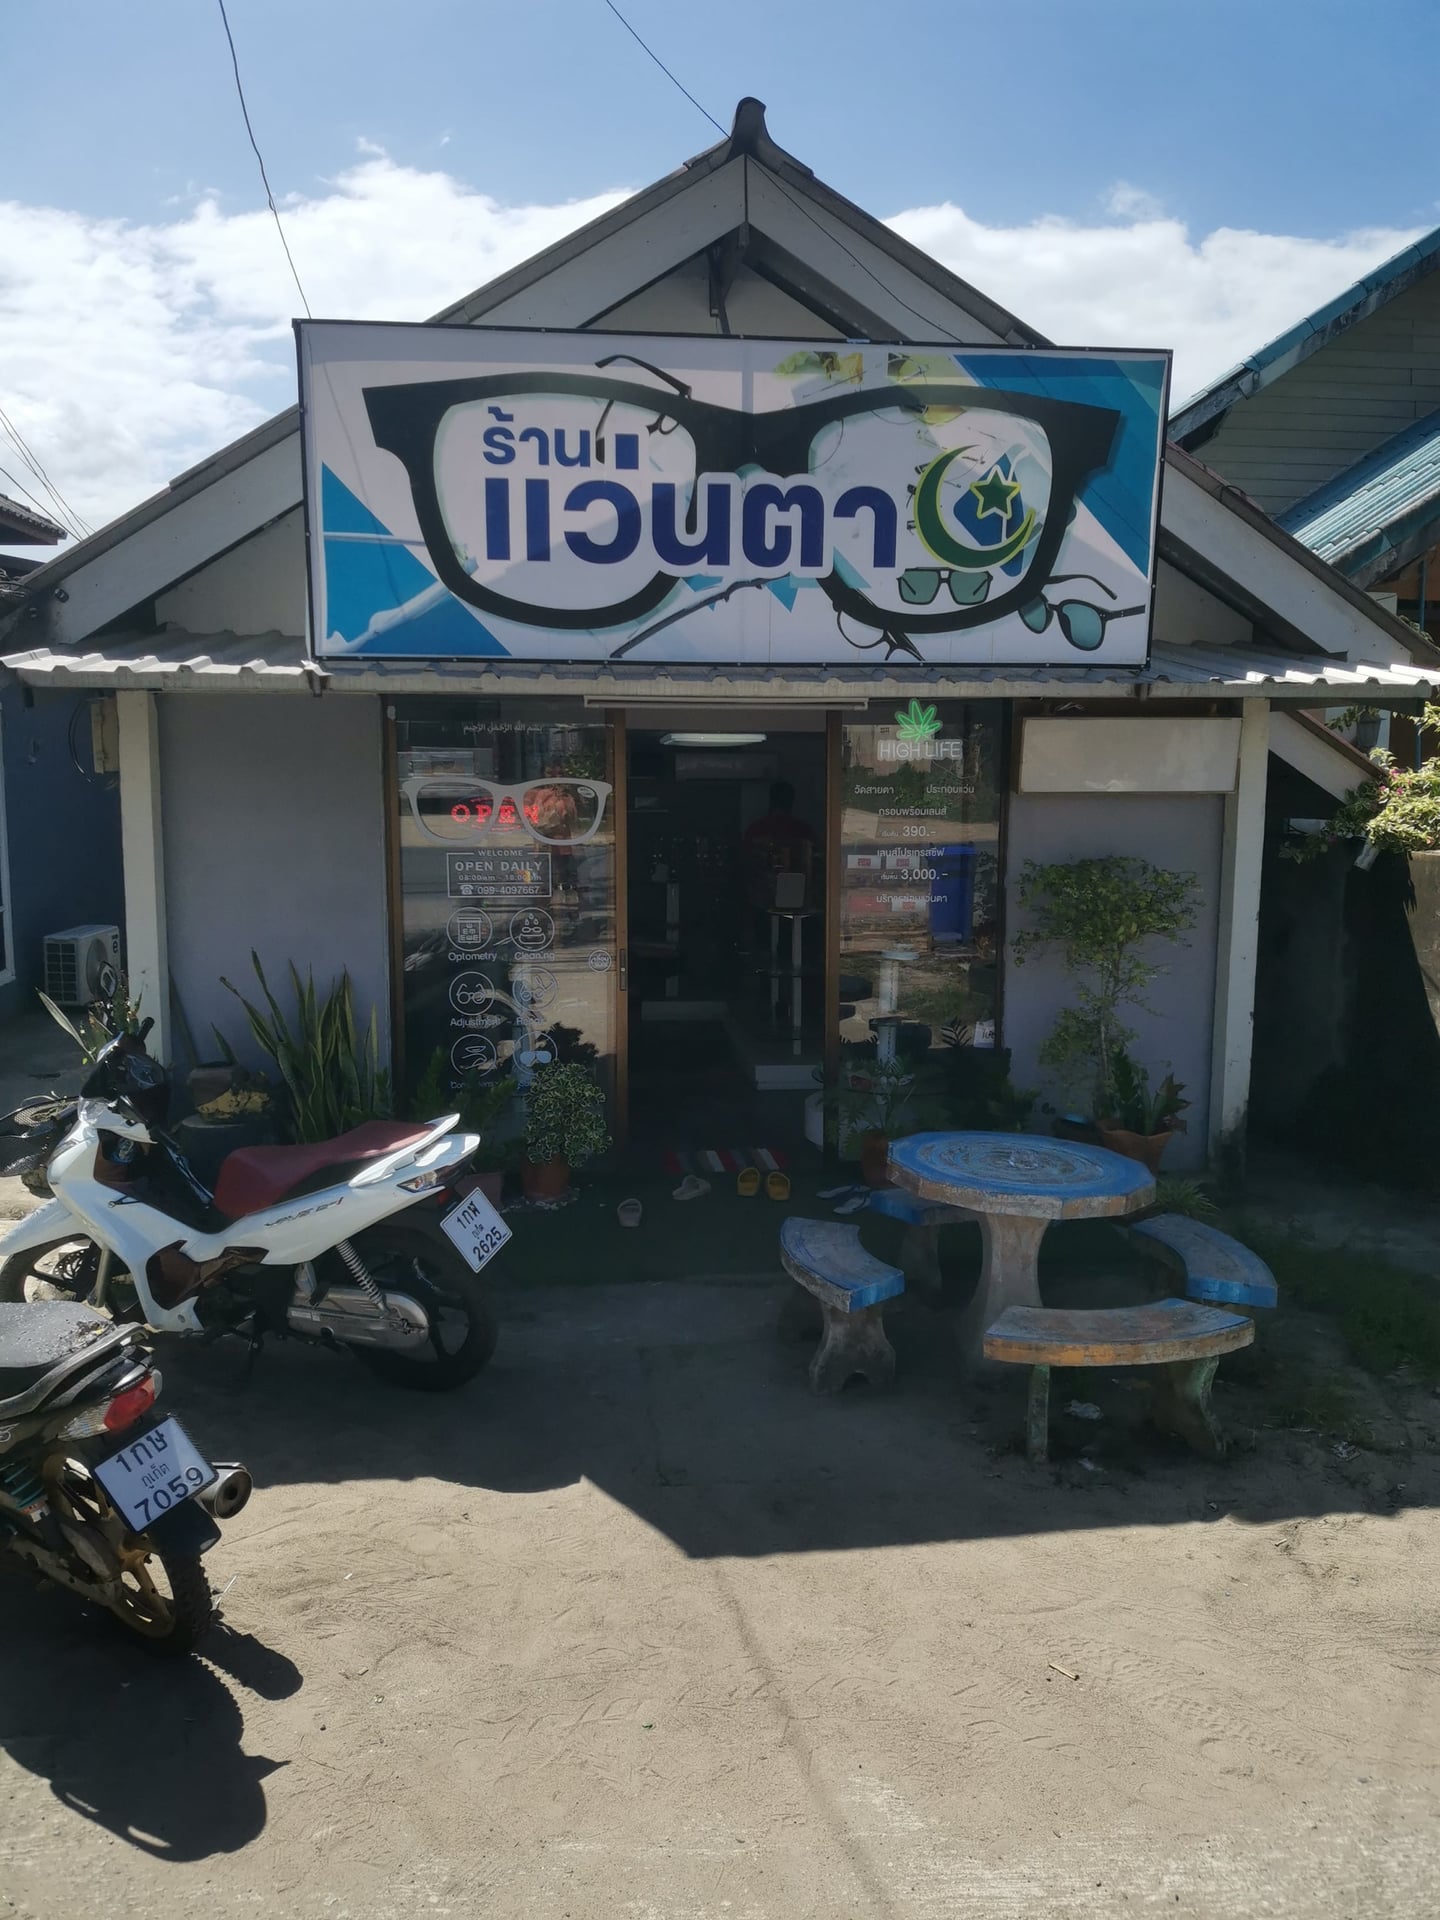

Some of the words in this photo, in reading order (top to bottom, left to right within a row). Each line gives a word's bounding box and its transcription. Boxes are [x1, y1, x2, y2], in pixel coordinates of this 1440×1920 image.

[482, 406, 591, 468] ร้าน
[484, 432, 898, 570] แว่นตา
[880, 742, 921, 759] HIGH
[925, 741, 963, 759] LIFE
[853, 784, 895, 794] วัดสายตา
[925, 783, 975, 794] ประกอบแว่น
[450, 803, 540, 825] OPEN
[878, 805, 947, 816] กรอบพร้อมเลนส์
[455, 861, 494, 871] OPEN
[501, 861, 542, 871] DAILY
[448, 951, 498, 962] Optometry
[472, 1226, 502, 1261] 2625
[116, 1429, 169, 1473] 1กษ
[141, 1463, 170, 1489] ภูเก็ต
[134, 1467, 204, 1522] 7059
